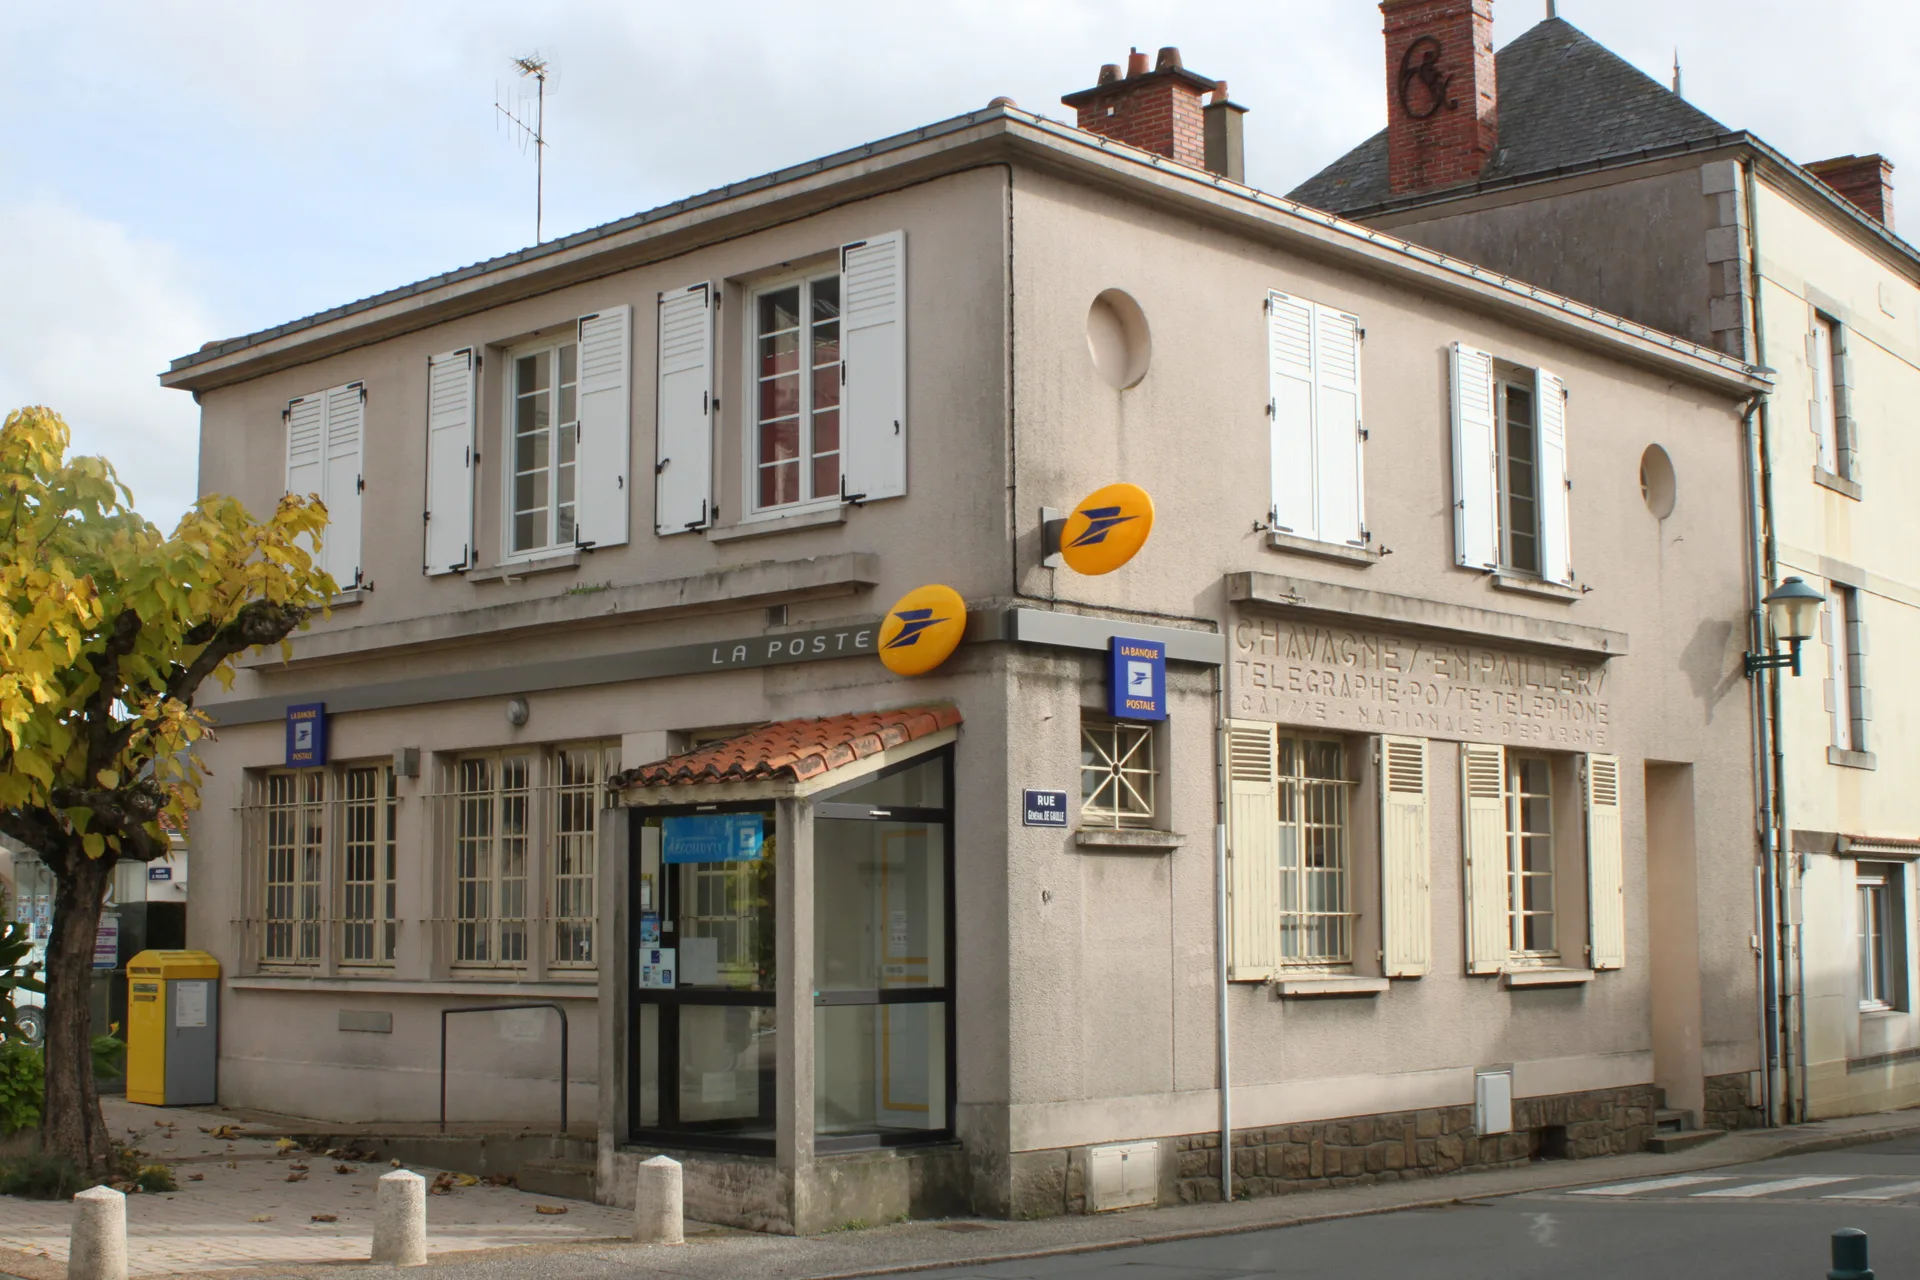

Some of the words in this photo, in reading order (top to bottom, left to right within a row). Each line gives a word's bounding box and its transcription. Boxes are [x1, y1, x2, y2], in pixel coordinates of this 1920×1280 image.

[711, 645, 747, 664] LA
[767, 630, 871, 659] POSTE
[1121, 646, 1130, 656] LA
[1131, 647, 1158, 659] BANQUE
[1434, 645, 1470, 682] EN
[1235, 660, 1400, 703] TELEGRAPHE
[1493, 690, 1609, 726] TELEPHONE
[1126, 700, 1155, 711] POSTALE
[297, 710, 316, 719] BANQUE
[1358, 705, 1483, 736] NATIONALE
[292, 752, 312, 760] POSTALE
[1037, 795, 1055, 806] RUE
[1044, 811, 1049, 821] DE
